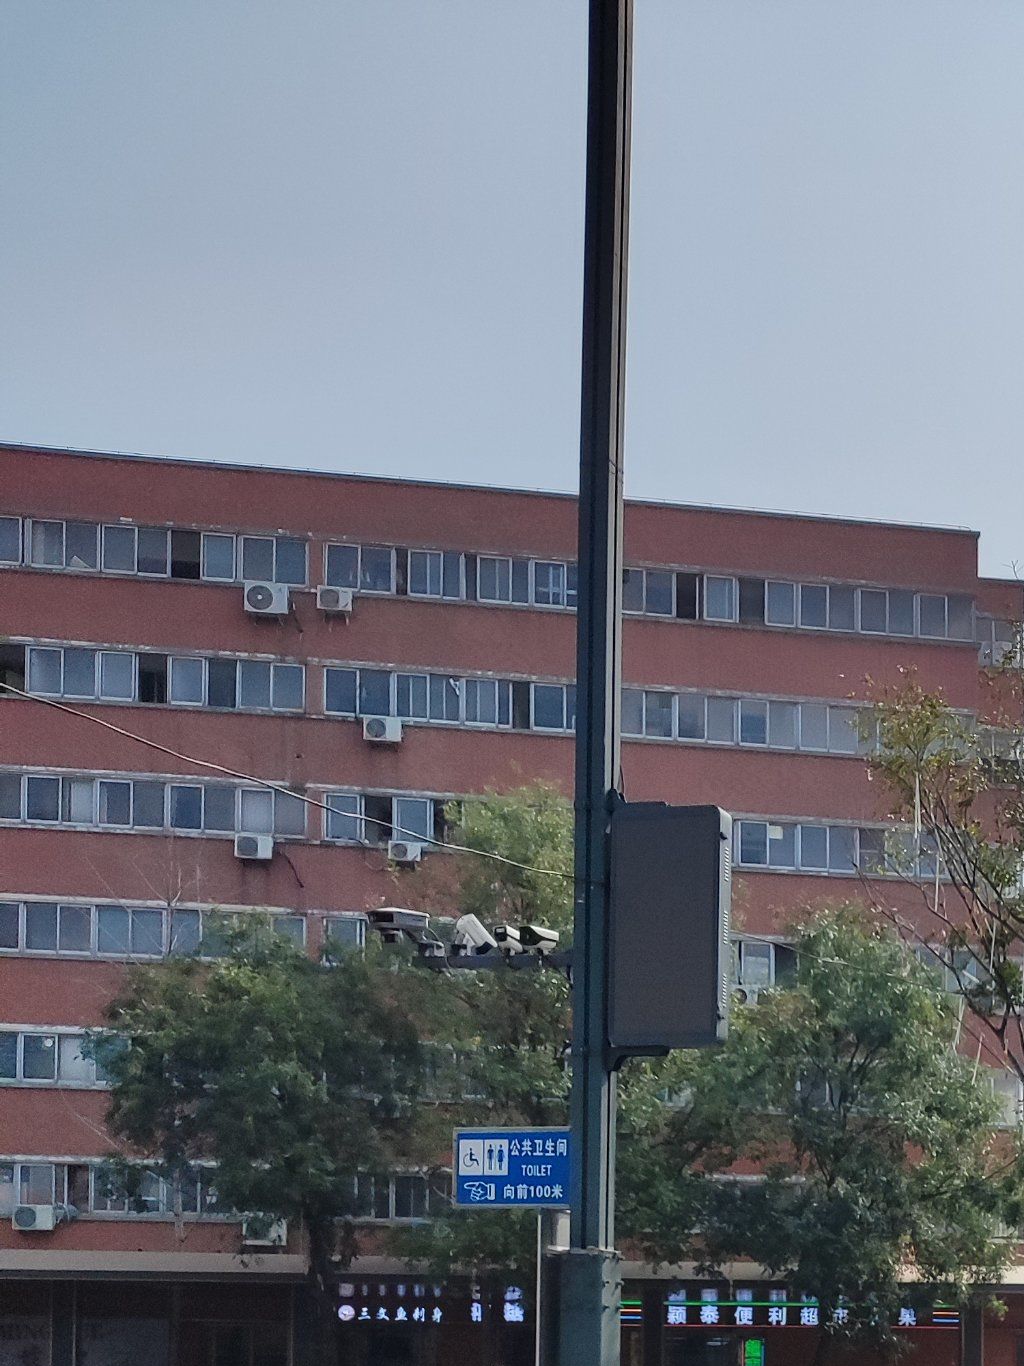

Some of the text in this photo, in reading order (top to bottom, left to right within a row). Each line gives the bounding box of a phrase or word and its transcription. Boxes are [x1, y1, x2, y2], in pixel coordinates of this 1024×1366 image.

[510, 1138, 567, 1157] 公共卫生间
[521, 1164, 552, 1177] TOILET
[503, 1183, 563, 1200] 向前100米
